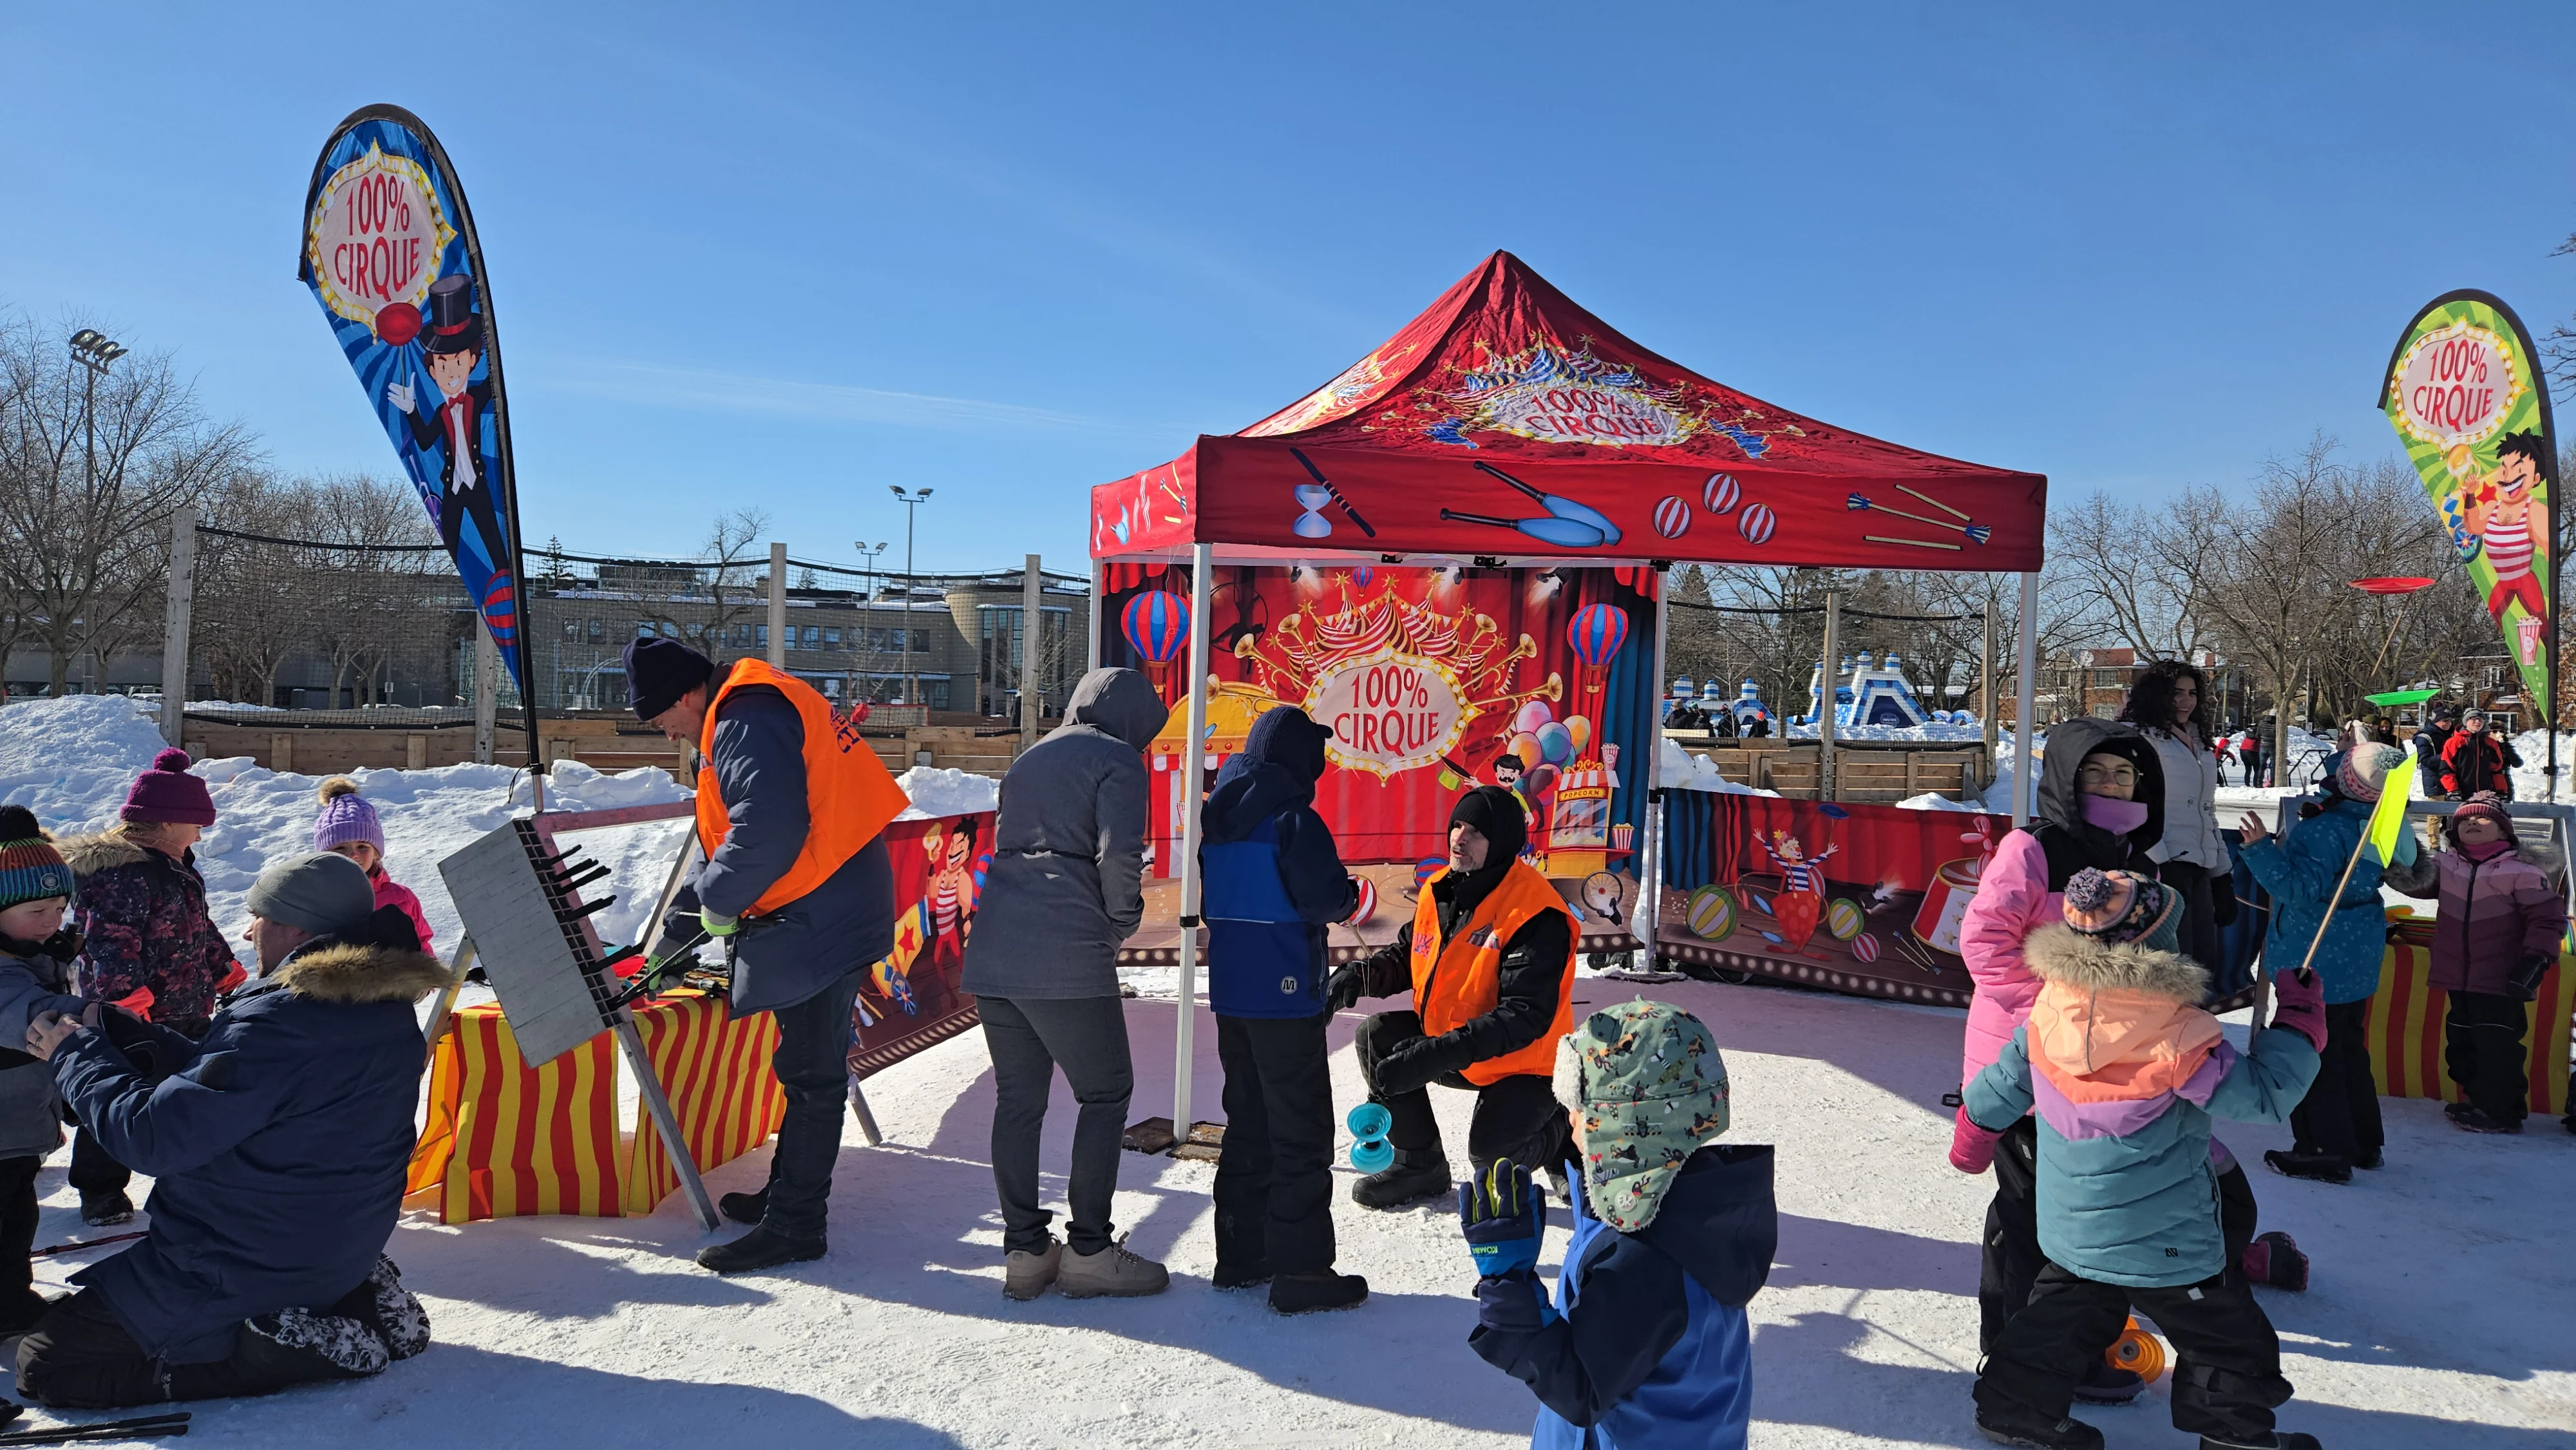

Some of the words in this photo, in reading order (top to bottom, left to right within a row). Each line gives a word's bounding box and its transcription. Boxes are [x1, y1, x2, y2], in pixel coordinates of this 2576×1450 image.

[346, 173, 410, 236] 100%
[334, 236, 420, 302] CIRQUE
[2429, 339, 2487, 383] 100%
[1531, 388, 1633, 416] 100%
[2413, 384, 2494, 432] CIRQUE
[1529, 415, 1662, 438] CIRQUE
[1352, 666, 1428, 709] 100%
[1334, 710, 1439, 756] CIRQUE
[1564, 790, 1600, 799] POPCORN
[1472, 1245, 1498, 1254] KOMBI
